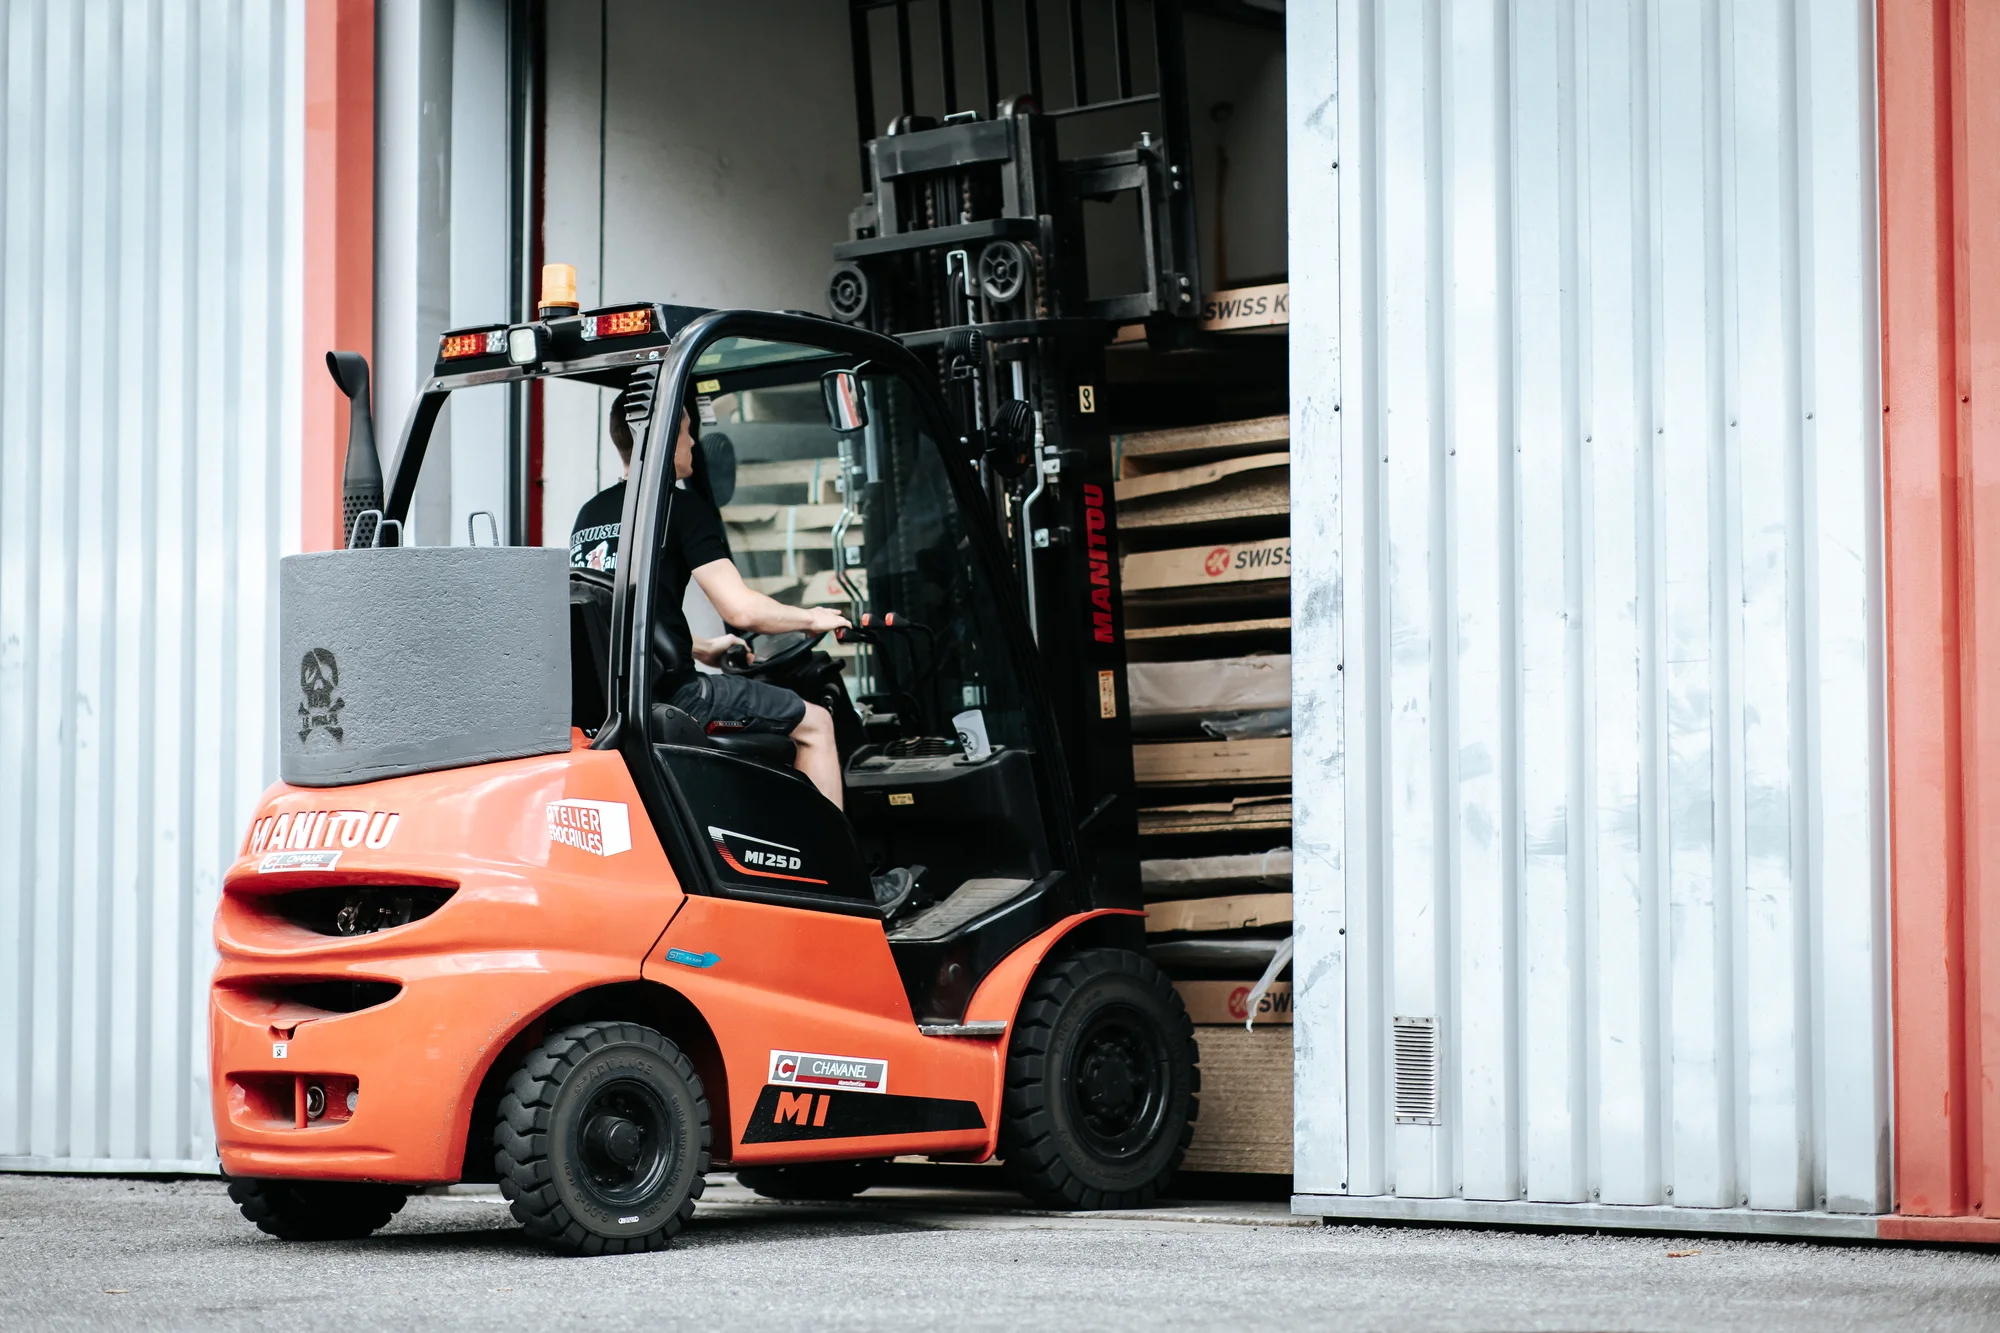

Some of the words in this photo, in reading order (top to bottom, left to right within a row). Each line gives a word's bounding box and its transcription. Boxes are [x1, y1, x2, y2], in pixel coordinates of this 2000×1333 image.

[1202, 296, 1268, 321] SWISS
[1274, 293, 1289, 313] K
[1084, 484, 1114, 643] MANITOU
[248, 810, 399, 855] MANITOU
[546, 805, 601, 832] ATELIER
[552, 824, 603, 856] ROCAILLES
[588, 1059, 653, 1080] ADVANCE
[778, 1059, 794, 1078] C
[812, 1061, 867, 1079] CHAVANEL
[773, 1091, 831, 1127] MI
